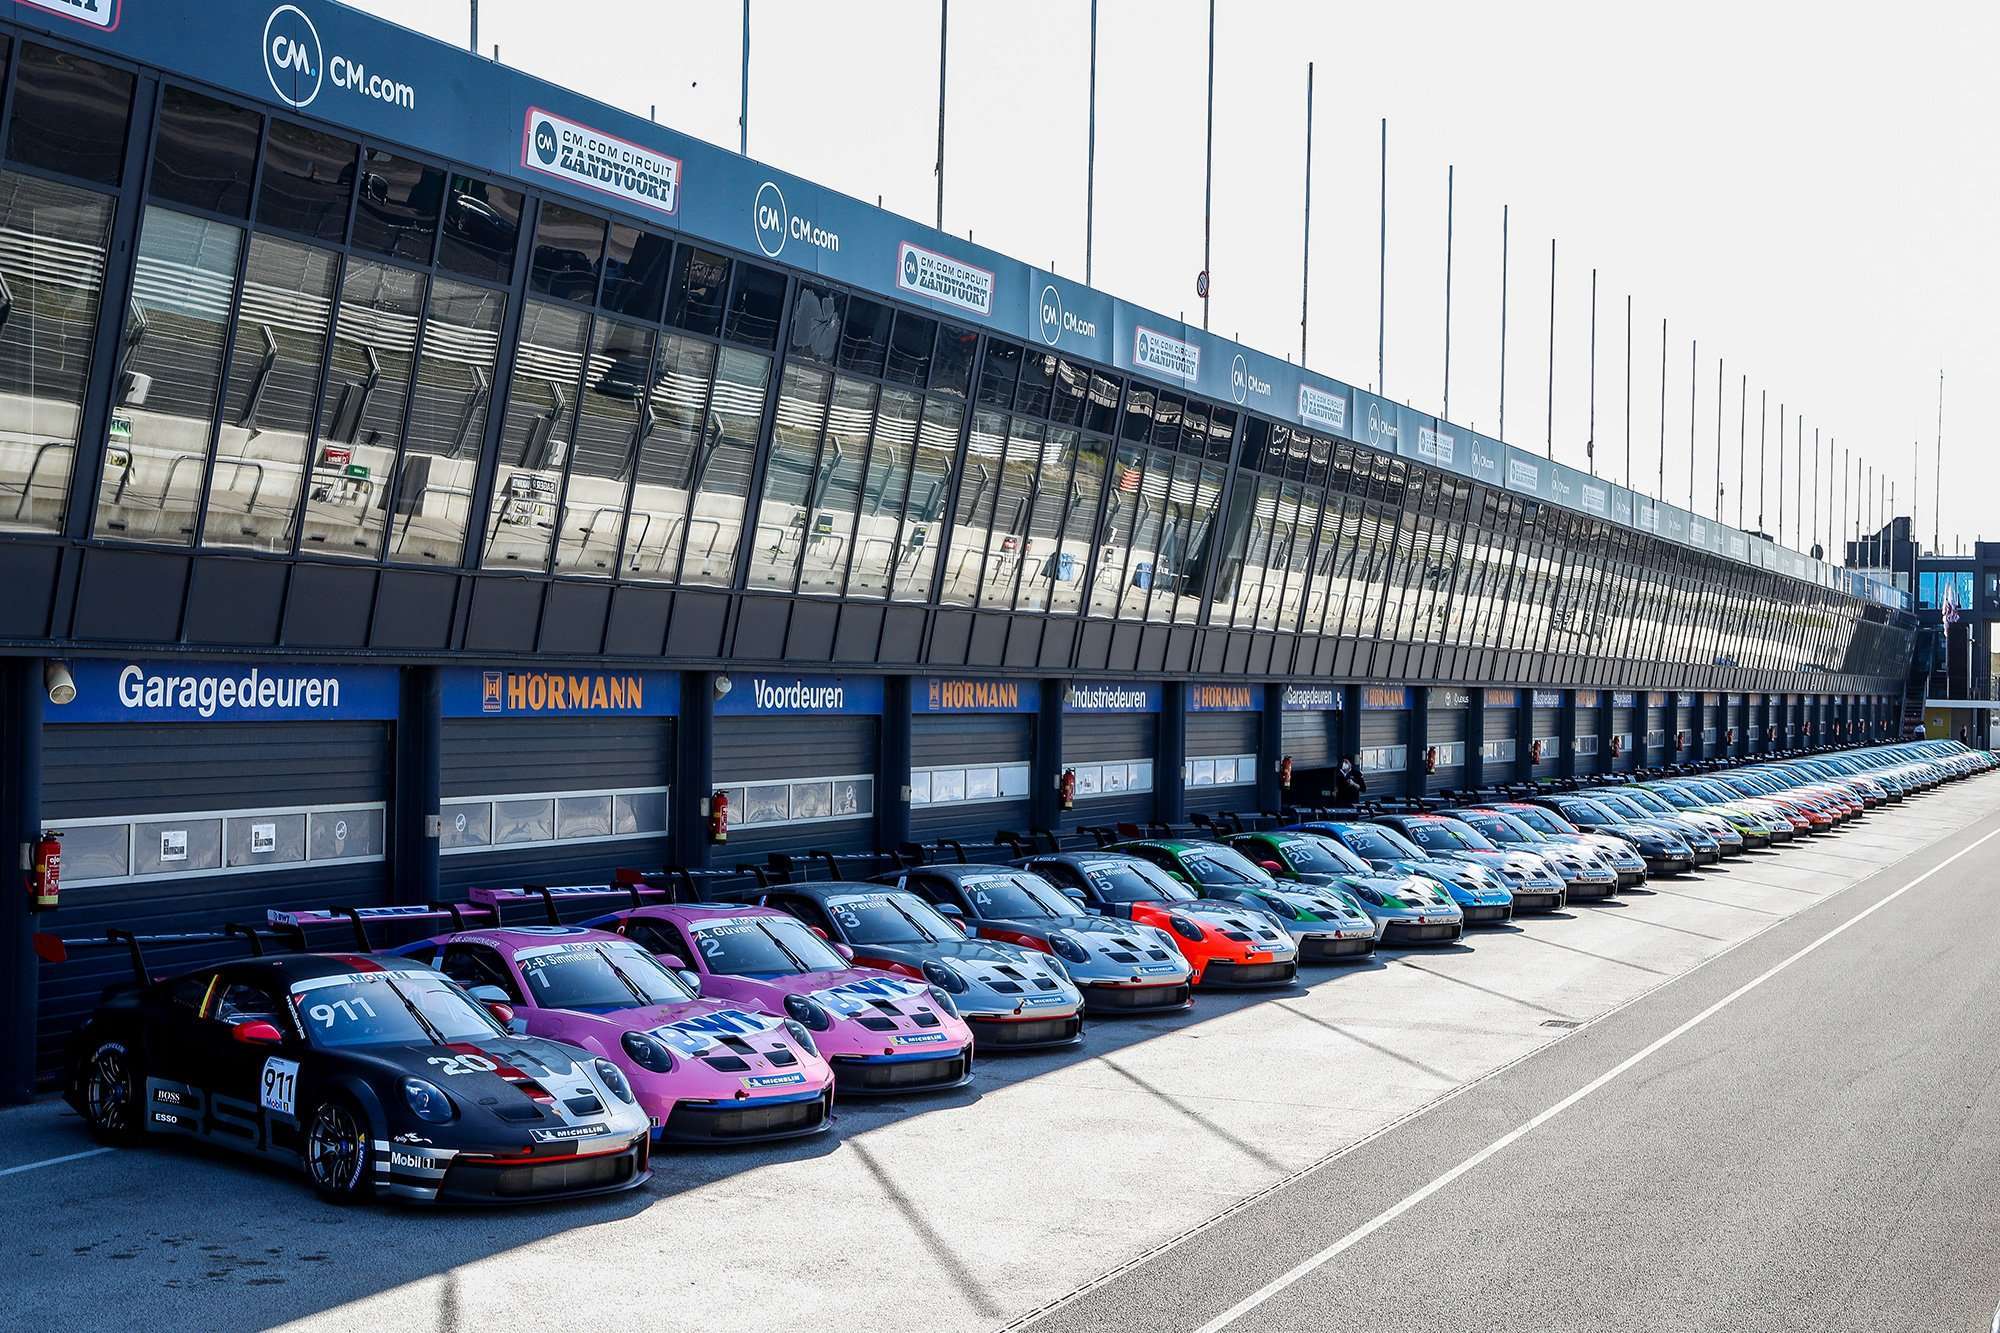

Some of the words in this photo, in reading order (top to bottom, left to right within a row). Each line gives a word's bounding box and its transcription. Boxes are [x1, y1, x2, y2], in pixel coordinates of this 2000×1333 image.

[329, 55, 415, 110] CM.com
[562, 130, 618, 159] CM.COM
[622, 151, 672, 178] CIRCUIT
[560, 144, 671, 202] ZANDVOORT
[790, 215, 840, 252] CM.com
[920, 256, 955, 276] CM.COM
[956, 269, 989, 287] CIRCUIT
[919, 267, 988, 307] ZANDVOORT
[1063, 311, 1096, 338] CM.com
[1248, 375, 1271, 397] CM.com
[118, 664, 339, 718] Garagedeuren
[507, 671, 642, 710] HÖRMANN
[754, 679, 843, 709] Voordeuren
[942, 680, 1018, 708] HÖRMANN
[1072, 684, 1146, 709] Industriedeuren
[1351, 838, 1375, 851] 22
[1190, 860, 1213, 875] 19
[1289, 850, 1313, 864] 20
[1095, 877, 1114, 891] 5
[976, 891, 992, 905] 4
[833, 905, 849, 914] D.
[839, 911, 861, 928] 3
[697, 929, 713, 940] A.
[701, 938, 725, 958] 2
[525, 957, 548, 970] J.-B.
[529, 968, 550, 988] 1
[810, 977, 909, 1016] BWT
[309, 997, 377, 1028] 911
[647, 1009, 766, 1055] BWT
[908, 1034, 942, 1043] MICHELIN
[427, 1054, 498, 1076] 20
[264, 1068, 294, 1103] 911
[762, 1075, 800, 1085] MICHELIN
[158, 1090, 180, 1101] BOSS
[155, 1113, 178, 1124] ESSO
[557, 1125, 604, 1137] MICHELIN
[391, 1151, 421, 1169] Mobil
